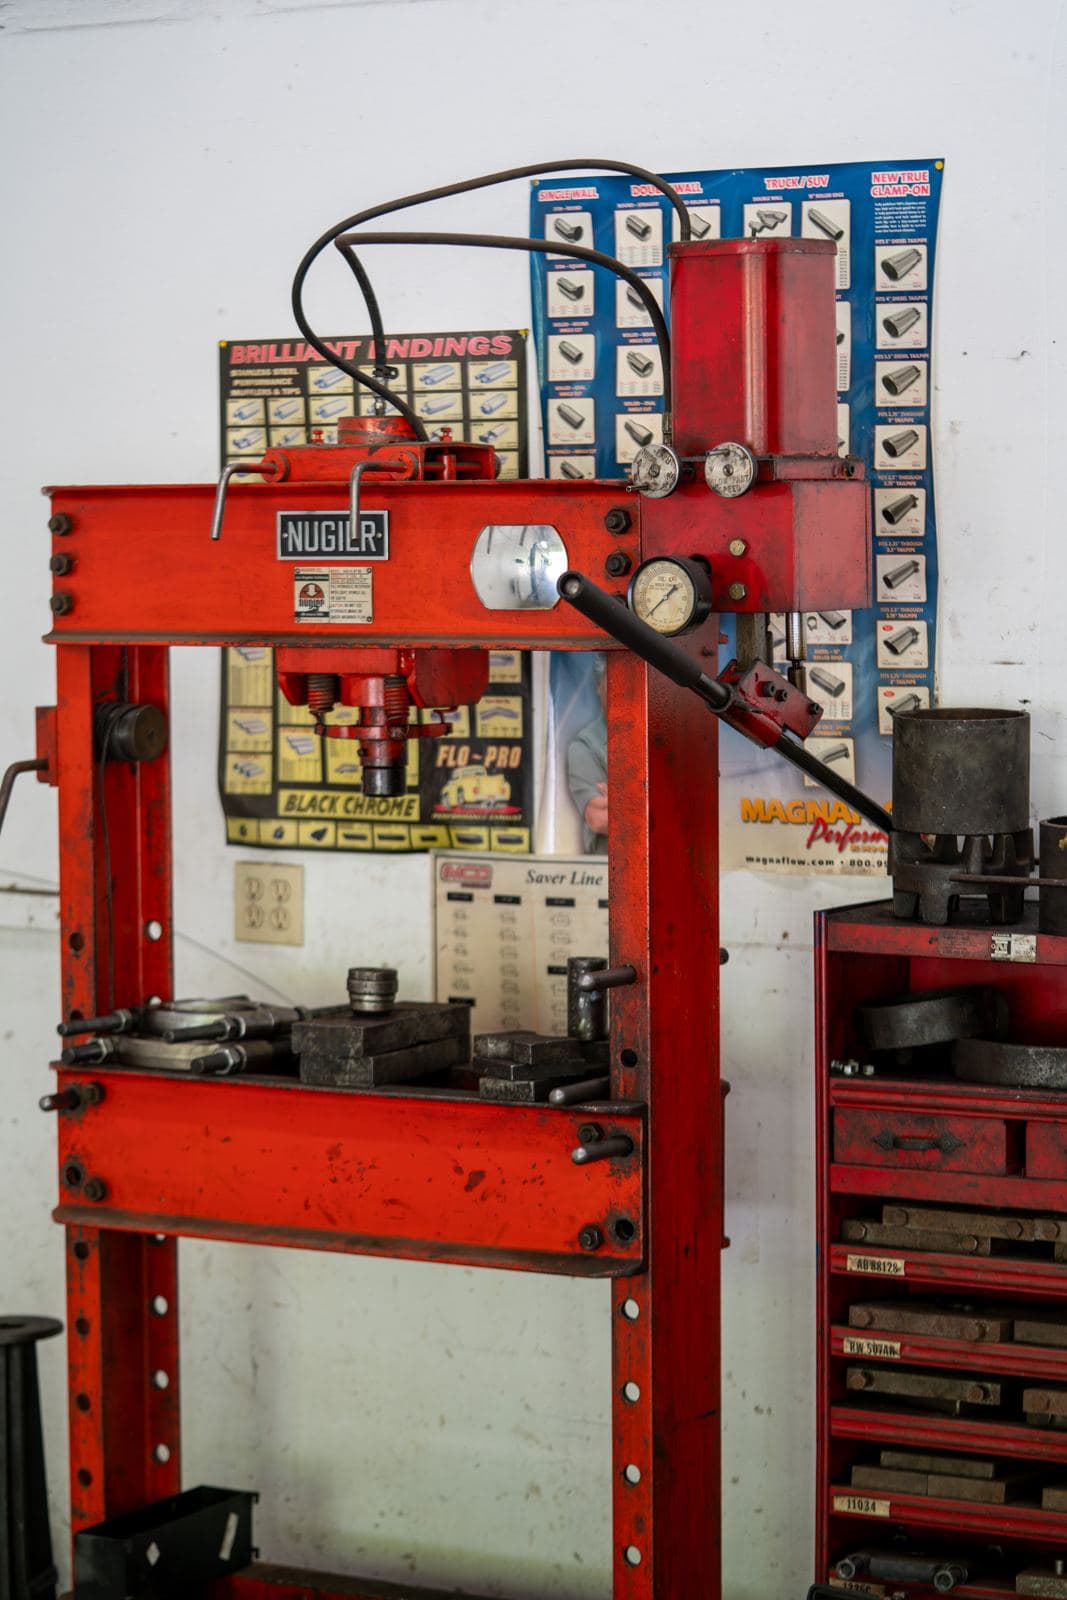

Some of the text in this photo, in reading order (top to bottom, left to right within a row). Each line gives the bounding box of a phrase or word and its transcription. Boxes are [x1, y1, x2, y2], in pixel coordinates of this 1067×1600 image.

[766, 177, 799, 189] TRUCK
[807, 175, 829, 187] SUV
[873, 172, 929, 183] NEW TRUE
[539, 188, 599, 201] SINGLE WALL
[872, 185, 930, 196] CLAMP-ON
[230, 340, 361, 364] BRILLIANT
[284, 794, 417, 818] BLACK CHROME
[745, 855, 835, 867] magnaflow.com
[526, 869, 603, 886] Saver Line
